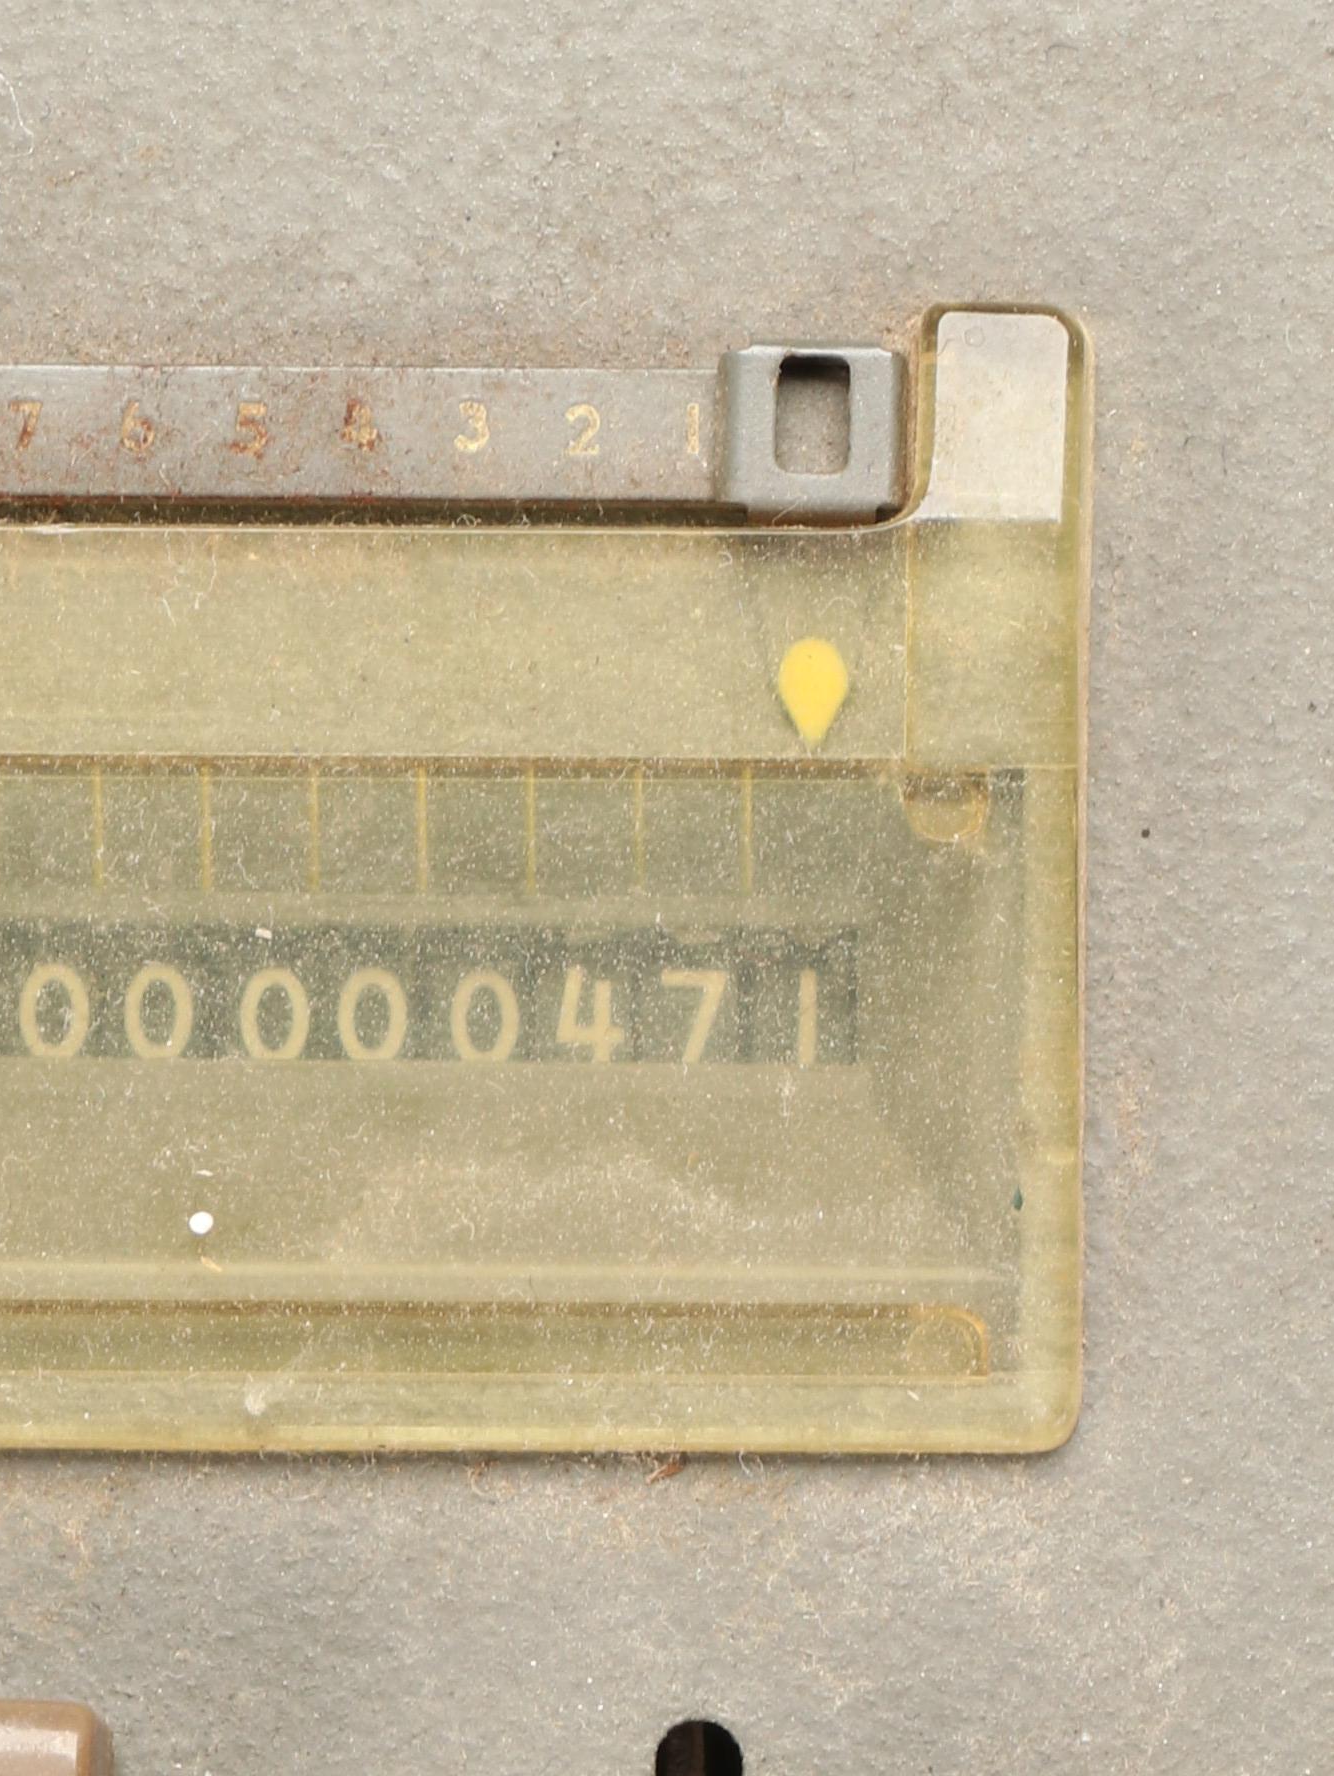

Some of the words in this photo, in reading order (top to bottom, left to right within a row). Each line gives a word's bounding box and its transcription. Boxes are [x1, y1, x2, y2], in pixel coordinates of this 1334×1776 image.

[9, 400, 43, 450] 7
[121, 401, 156, 454] 6
[228, 401, 267, 456] 5
[453, 400, 490, 453] 3
[566, 403, 600, 456] 2
[687, 402, 699, 455] 1
